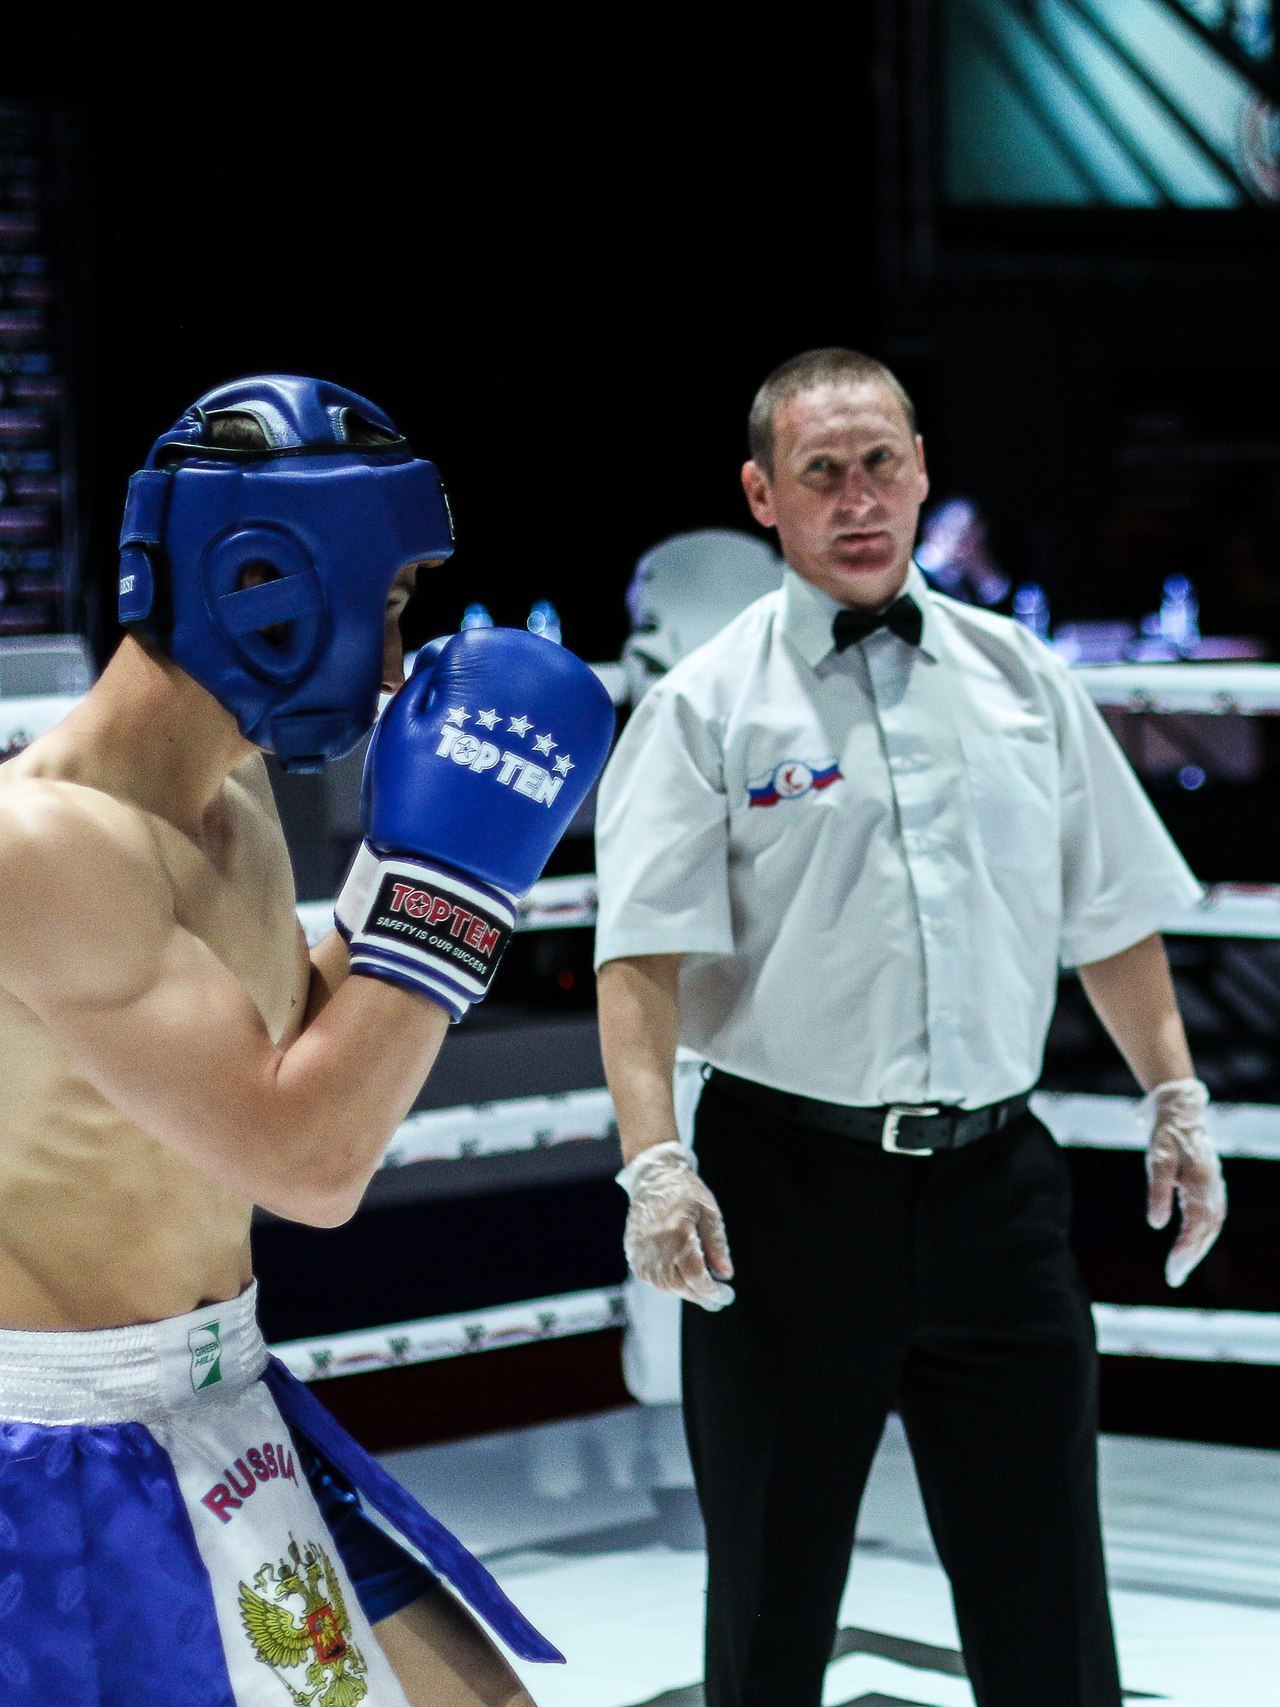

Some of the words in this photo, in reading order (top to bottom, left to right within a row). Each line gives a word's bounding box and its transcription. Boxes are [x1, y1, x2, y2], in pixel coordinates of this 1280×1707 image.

[436, 724, 500, 773] TOP
[496, 751, 564, 808] TEN
[376, 916, 418, 935] SAFETY
[415, 927, 429, 940] IS
[428, 935, 454, 952] OUR
[452, 947, 488, 975] SUCCESS
[390, 883, 452, 926] TOP
[450, 905, 500, 958] TEN
[195, 1340, 219, 1357] GREEN
